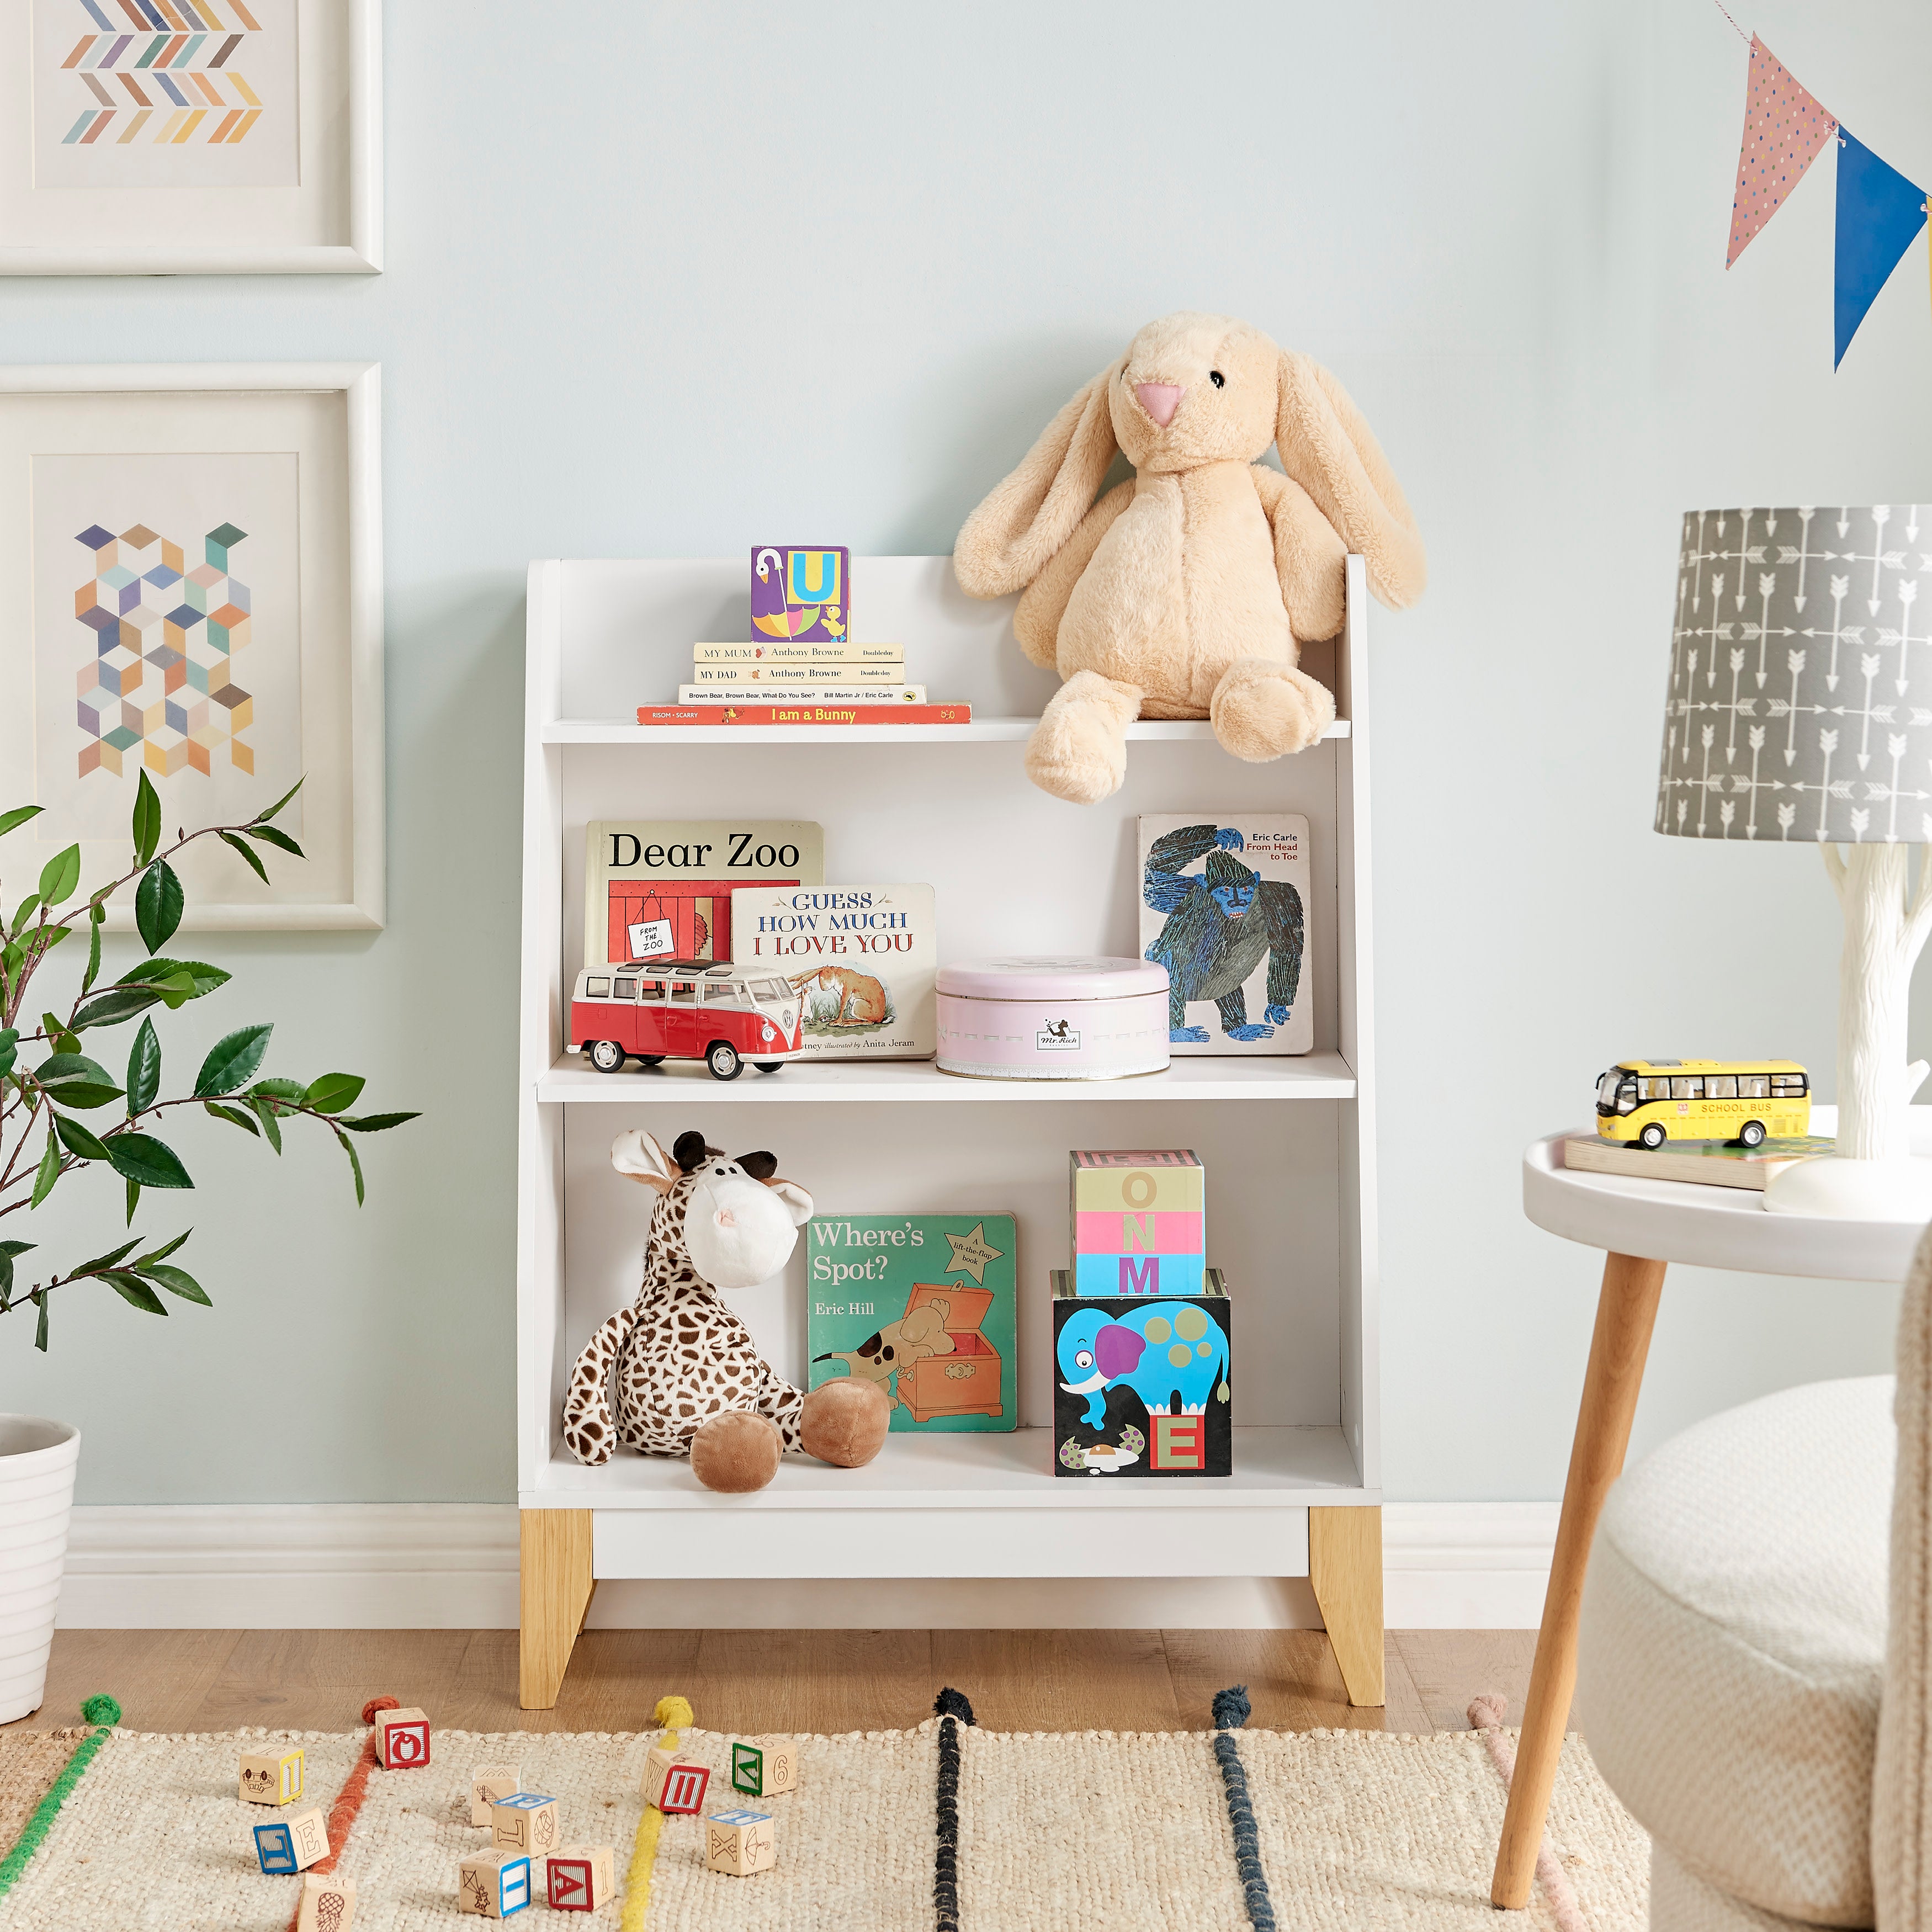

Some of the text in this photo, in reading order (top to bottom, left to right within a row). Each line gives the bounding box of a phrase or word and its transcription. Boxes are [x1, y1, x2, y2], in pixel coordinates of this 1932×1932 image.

[793, 553, 835, 602] U
[725, 649, 751, 657] MUM
[771, 648, 808, 657] Anthony
[718, 671, 737, 679] DAD
[769, 670, 805, 679] Anthony
[772, 708, 776, 720] I
[779, 711, 800, 720] am
[803, 711, 812, 720] a
[815, 708, 856, 724] Bunny
[608, 834, 800, 867] Dear Zoo
[792, 893, 872, 910] GUESS
[640, 926, 657, 936] FROM
[758, 912, 908, 933] HOW MUCH
[643, 940, 663, 951] ZOO
[645, 933, 657, 941] THE
[753, 933, 914, 956] I LOVE YOU
[863, 1039, 885, 1048] Anita
[888, 1039, 914, 1047] Jeram
[1702, 1104, 1745, 1112] SCHOOL
[1122, 1171, 1157, 1209] O
[812, 1222, 923, 1246] Where's
[1123, 1214, 1155, 1251] N
[954, 1242, 992, 1260] lift-the-flap
[962, 1255, 978, 1265] book
[814, 1255, 888, 1286] Spot?
[1119, 1257, 1159, 1293] M
[815, 1303, 874, 1315] Eric Hill
[1157, 1417, 1198, 1467] E
[296, 1819, 321, 1859] E
[712, 1829, 737, 1862] X
[554, 1866, 584, 1902] A
